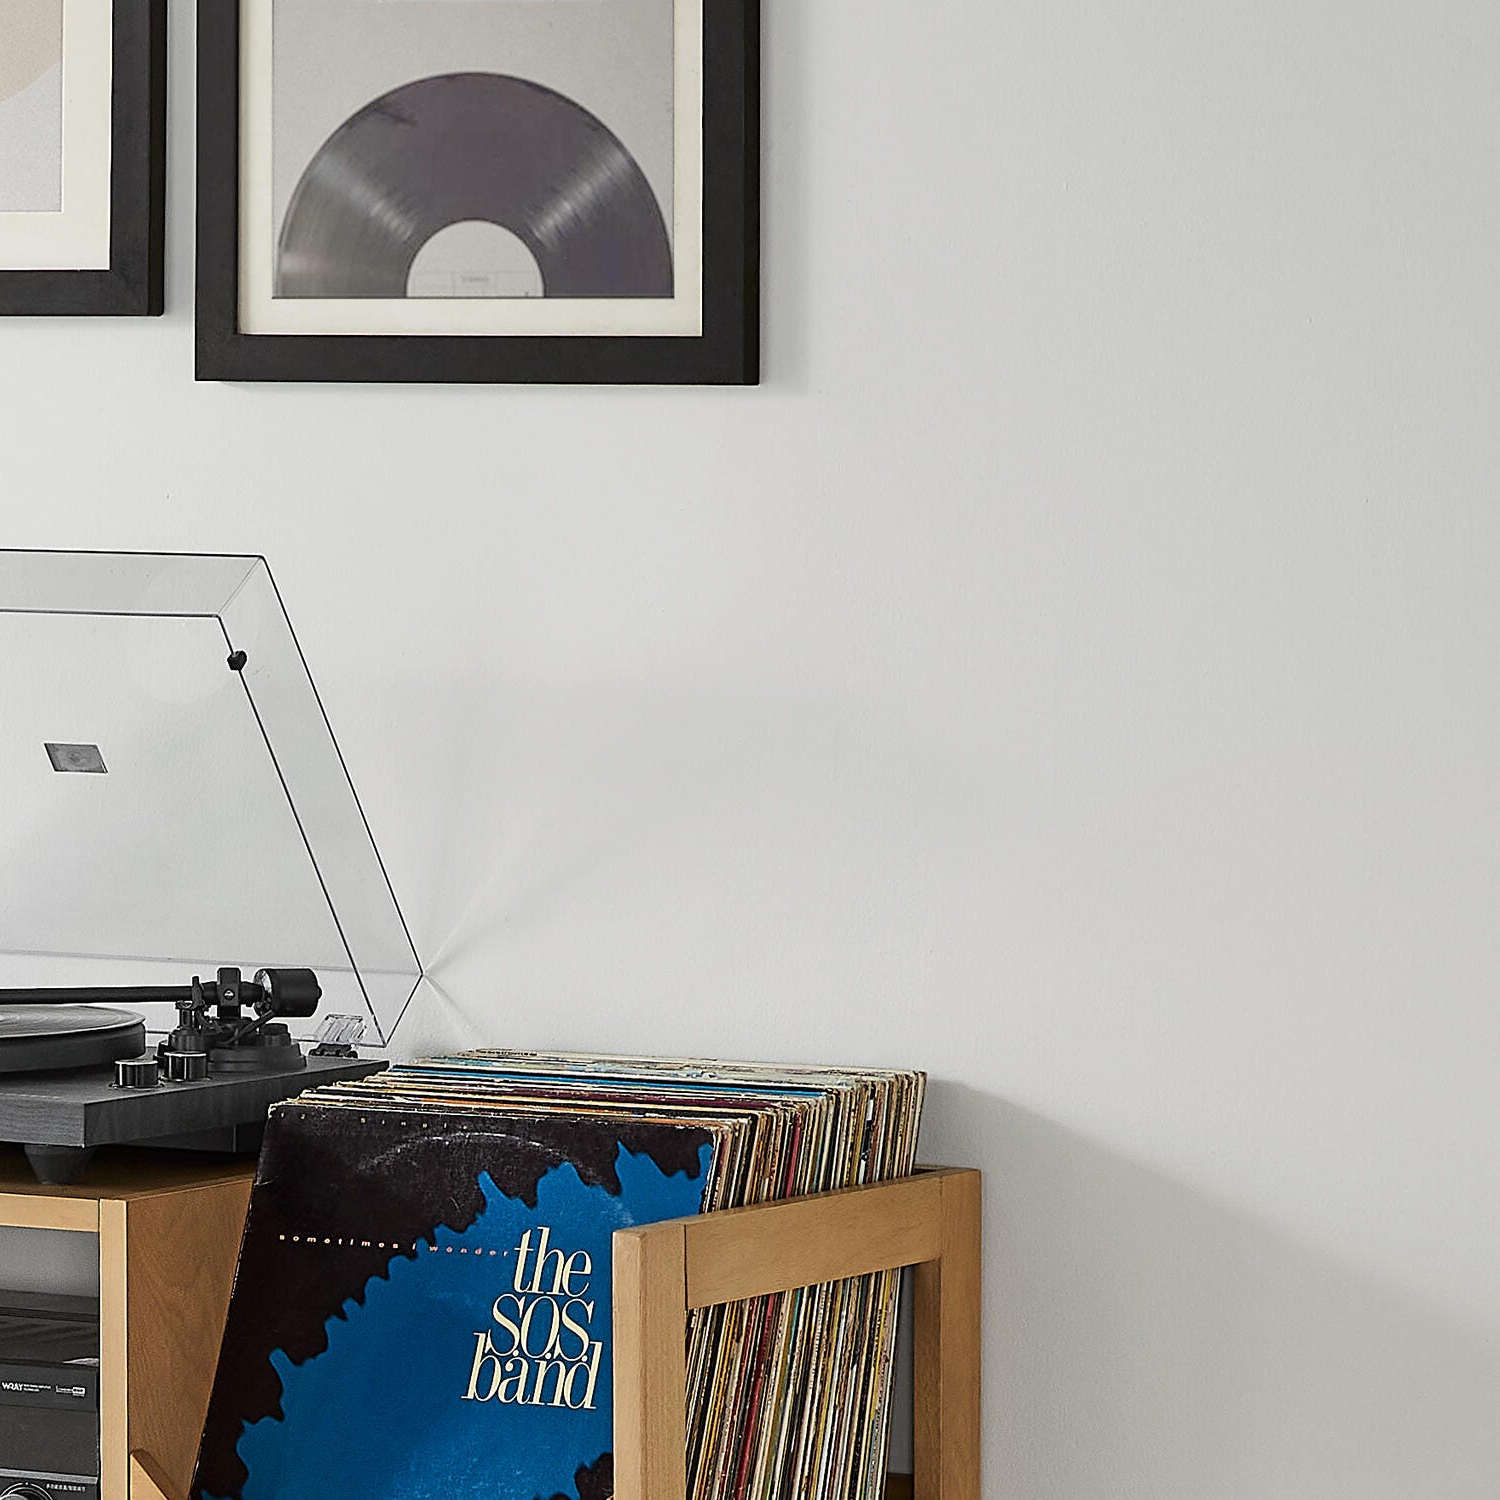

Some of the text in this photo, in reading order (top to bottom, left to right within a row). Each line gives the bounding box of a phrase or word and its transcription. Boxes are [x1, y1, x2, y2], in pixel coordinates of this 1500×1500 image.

[279, 1234, 399, 1250] sometimes
[429, 1245, 509, 1258] wonder
[513, 1226, 592, 1297] the
[461, 1332, 603, 1409] band
